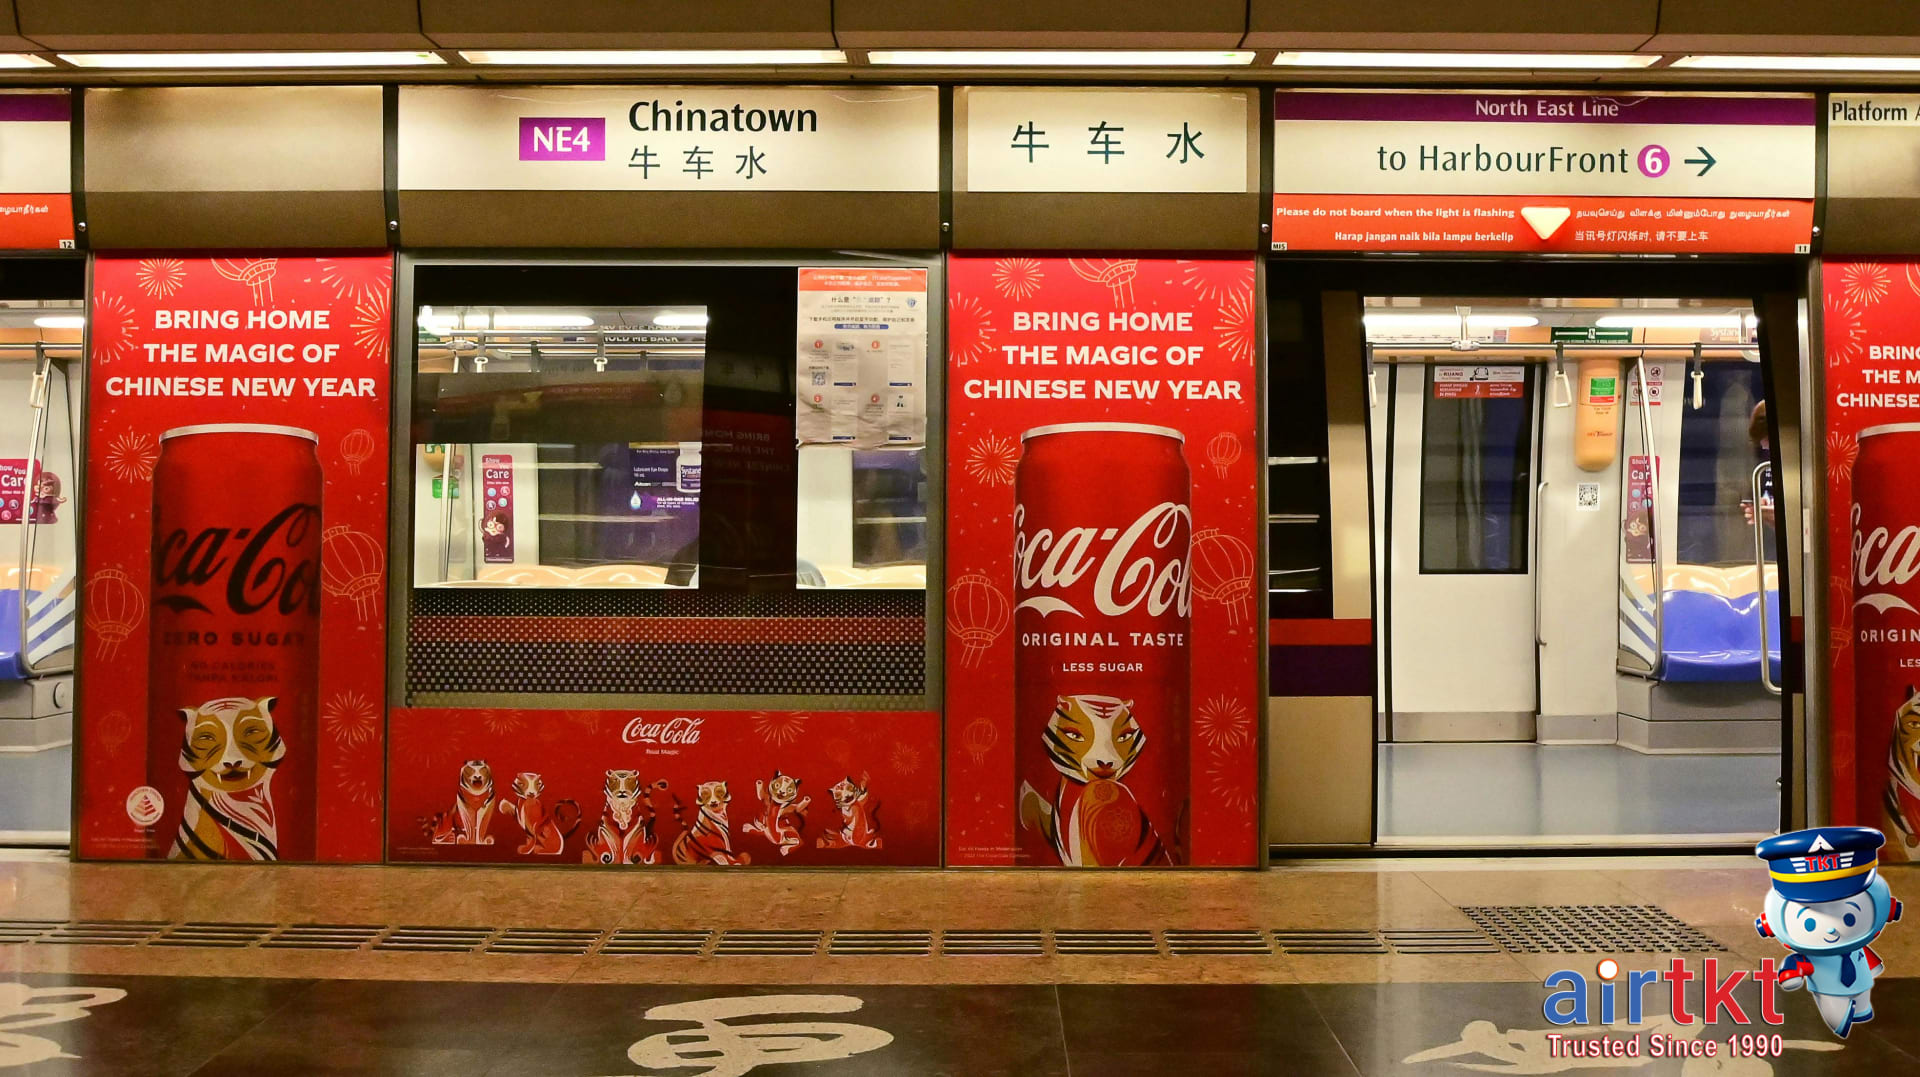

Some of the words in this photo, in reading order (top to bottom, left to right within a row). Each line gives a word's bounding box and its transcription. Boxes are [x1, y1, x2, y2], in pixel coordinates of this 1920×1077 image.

[628, 100, 817, 132] Chinatown
[1475, 100, 1528, 117] North
[1536, 101, 1575, 117] East
[1582, 101, 1619, 117] Line
[1832, 100, 1907, 121] Platform
[533, 126, 591, 152] NE4
[1011, 121, 1204, 164] 牛车水
[628, 145, 767, 179] 牛车水
[1377, 146, 1407, 171] to
[1419, 144, 1629, 174] HarbourFront
[1644, 148, 1664, 174] 6
[1276, 208, 1310, 216] Please
[1312, 208, 1326, 216] do
[1350, 208, 1381, 216] board
[1384, 208, 1413, 216] when
[1416, 208, 1433, 216] the
[1435, 208, 1459, 218] light
[1462, 208, 1471, 216] is
[1473, 208, 1515, 218] flashing
[62, 241, 73, 249] 12
[1335, 232, 1363, 243] Harap
[1365, 232, 1397, 243] jangan
[1399, 232, 1420, 241] naik
[1422, 232, 1440, 241] bila
[1443, 232, 1472, 243] lampu
[1475, 232, 1514, 243] berkelip
[155, 310, 240, 329] BRING
[248, 310, 330, 329] HOME
[1013, 311, 1099, 331] BRING
[1109, 311, 1193, 331] HOME
[144, 344, 197, 362] THE
[205, 344, 295, 363] MAGIC
[302, 344, 340, 362] OF
[1002, 345, 1057, 364] THE
[1066, 345, 1158, 365] MAGIC
[1165, 345, 1204, 365] OF
[1861, 369, 1901, 384] THE
[105, 377, 224, 396] CHINESE
[231, 378, 296, 396] NEW
[303, 378, 376, 396] YEAR
[963, 379, 1086, 399] CHINESE
[1094, 380, 1160, 399] NEW
[1167, 380, 1242, 399] YEAR
[1836, 392, 1920, 408] CHINESE
[1, 474, 27, 487] Car
[485, 469, 510, 479] Care
[1631, 470, 1651, 480] Car
[164, 632, 218, 646] ZERO
[1022, 632, 1119, 646] ORIGINAL
[1129, 632, 1184, 646] TASTE
[1062, 663, 1094, 671] LESS
[1099, 663, 1144, 672] SUGAR
